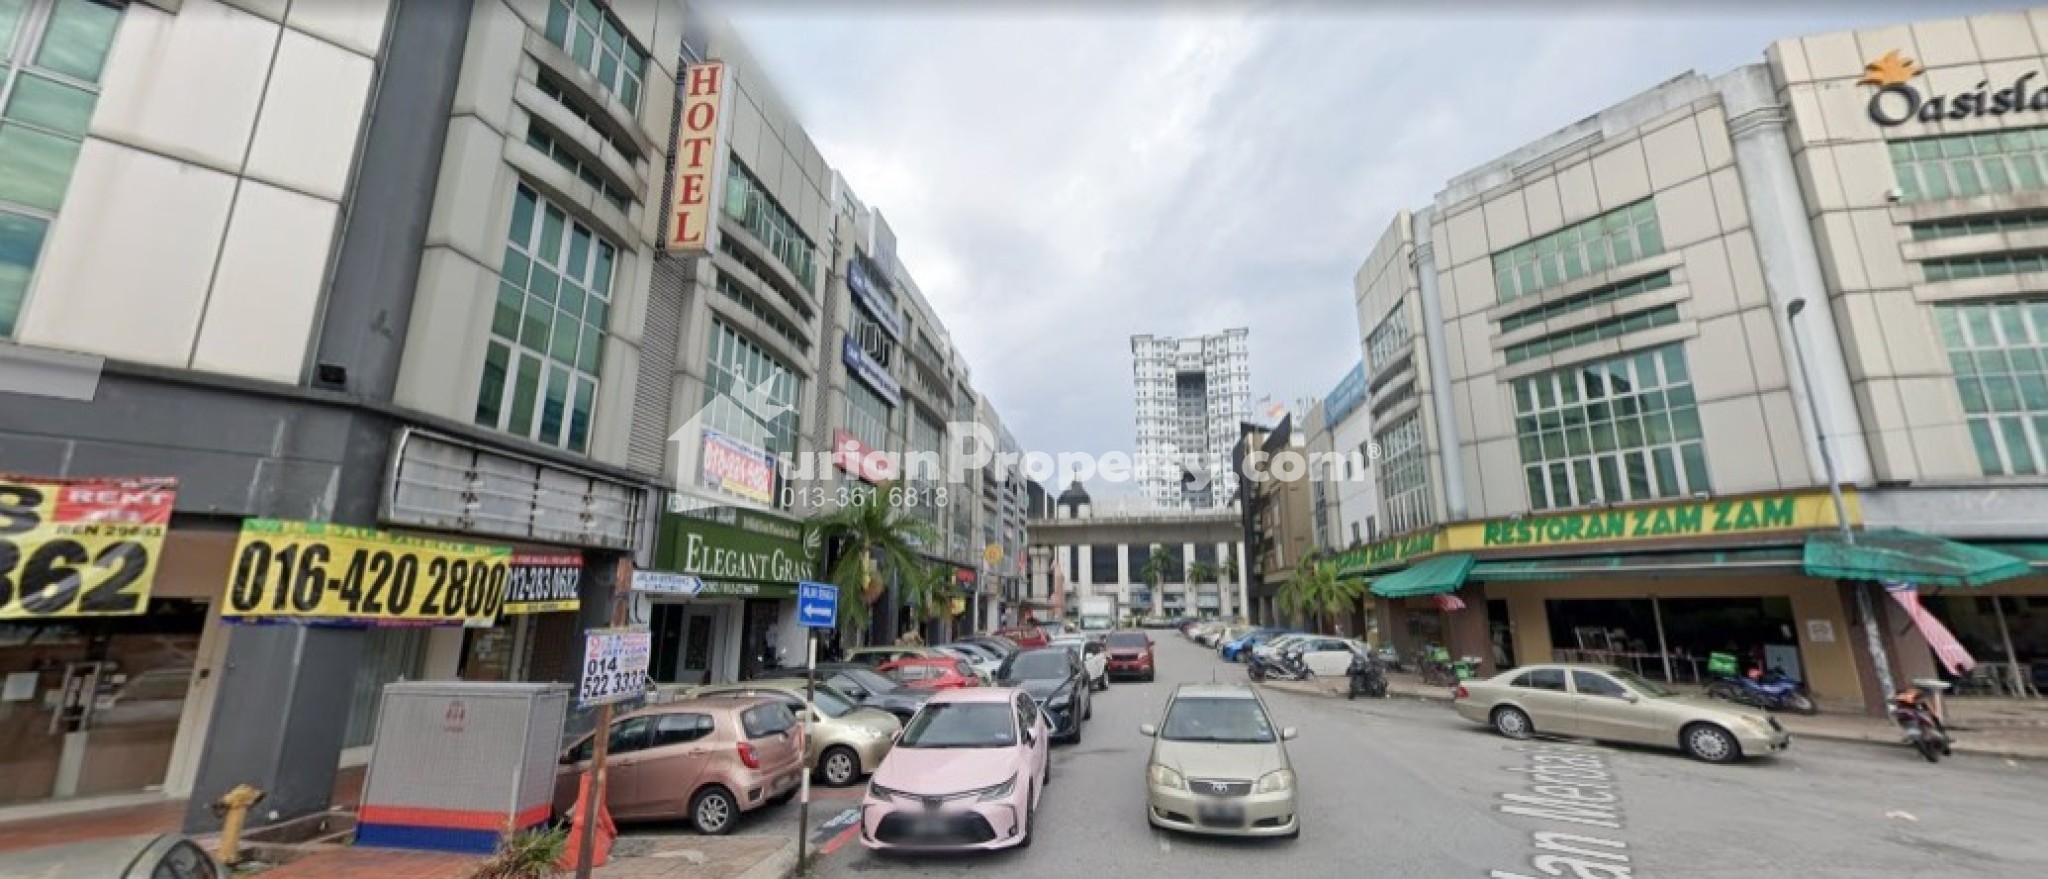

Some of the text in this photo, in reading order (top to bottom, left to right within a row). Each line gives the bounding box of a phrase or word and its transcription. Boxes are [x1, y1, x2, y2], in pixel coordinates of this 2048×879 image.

[674, 66, 720, 242] HOTEL
[1484, 496, 1795, 545] RESTORAN ZAM ZAM
[230, 540, 505, 617] 016-420 2800
[684, 532, 813, 582] ELEGANT GRASS
[584, 674, 608, 700] 522
[588, 657, 617, 676] 014
